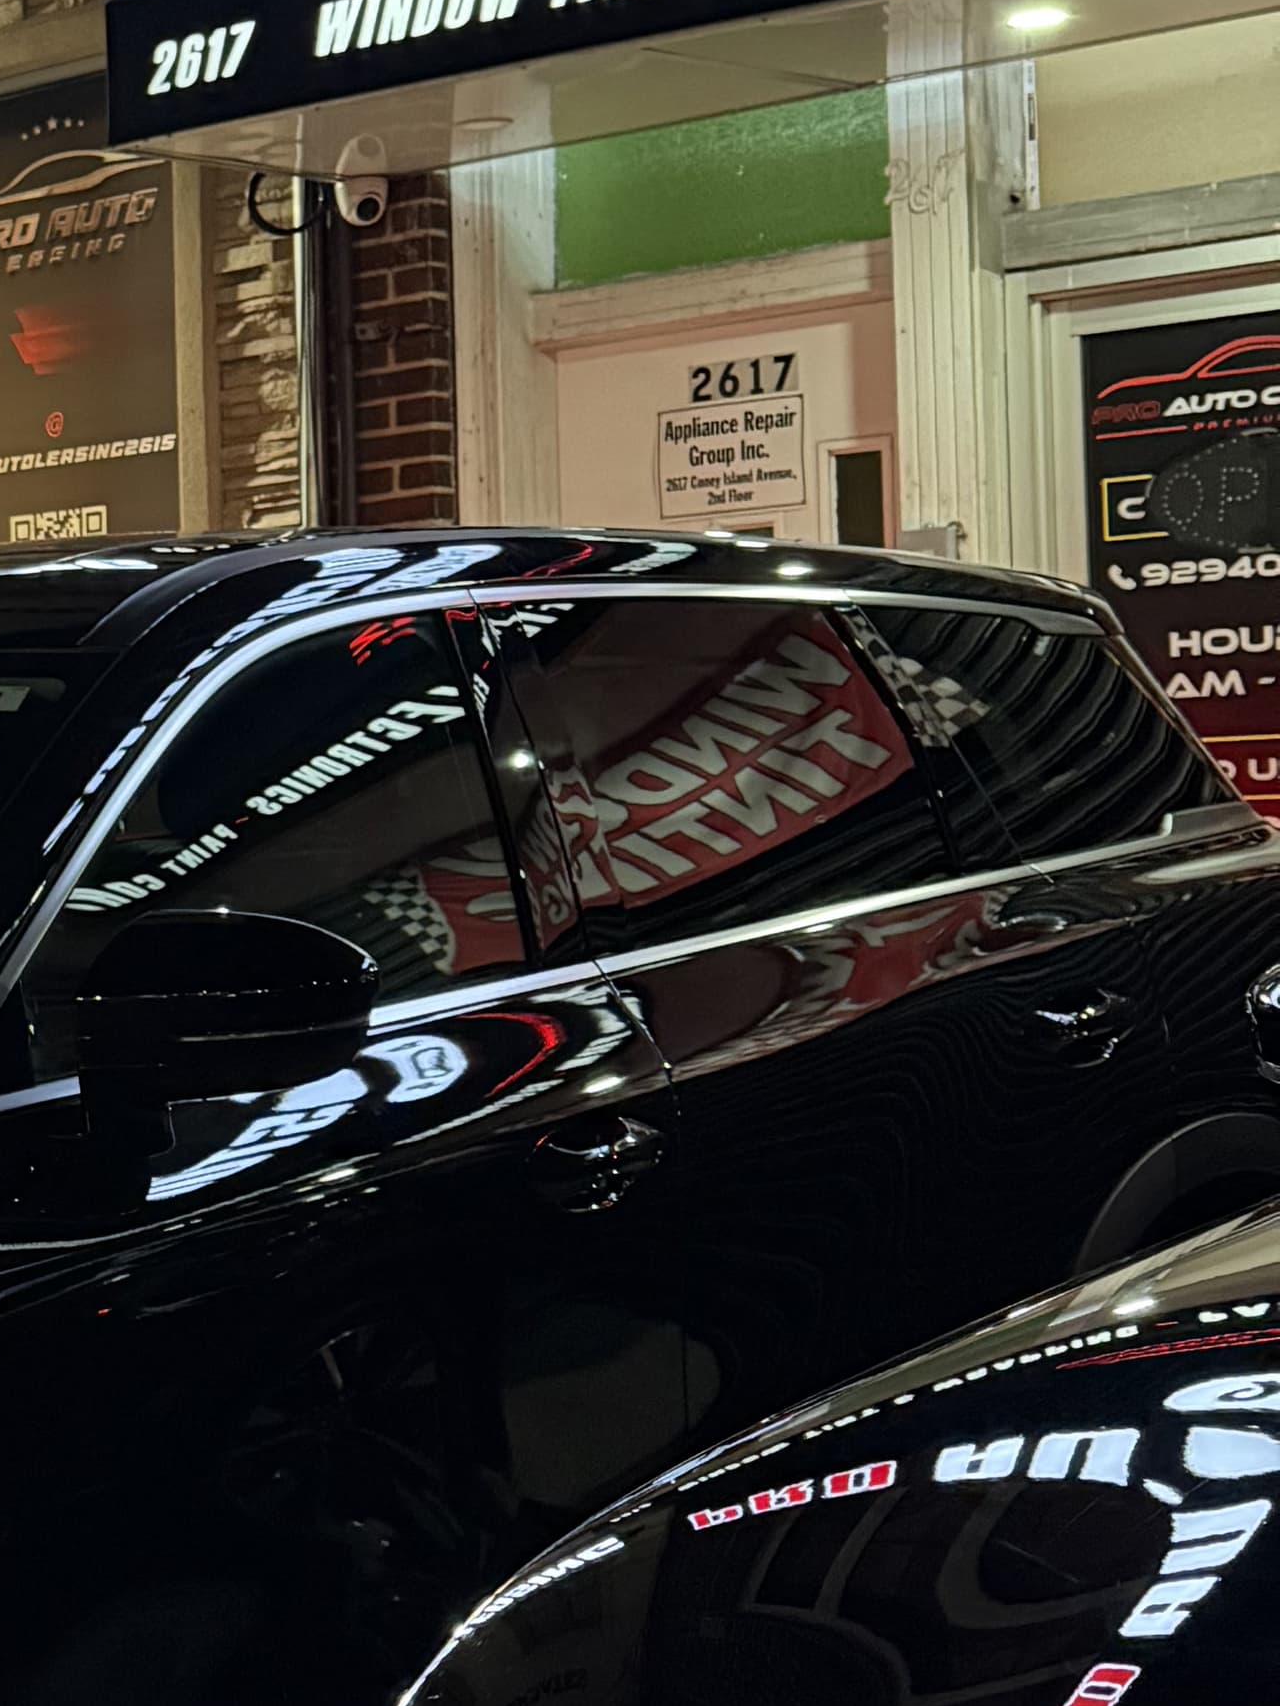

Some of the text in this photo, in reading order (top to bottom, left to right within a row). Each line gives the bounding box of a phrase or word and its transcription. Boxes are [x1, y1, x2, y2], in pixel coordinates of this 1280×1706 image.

[146, 20, 256, 96] 2617
[44, 187, 159, 242] AUTO
[691, 353, 796, 403] 2617
[1091, 400, 1161, 425] PRO
[1161, 389, 1258, 418] AUTO
[1192, 413, 1280, 431] PREMIU
[664, 405, 797, 445] Appliance Repair
[689, 439, 770, 468] Group Inc.
[665, 476, 688, 493] 2617
[690, 475, 721, 490] Coney
[723, 471, 753, 486] Island
[707, 489, 755, 506] 2nd Floor
[1168, 624, 1280, 659] HOU
[1164, 669, 1247, 699] AM
